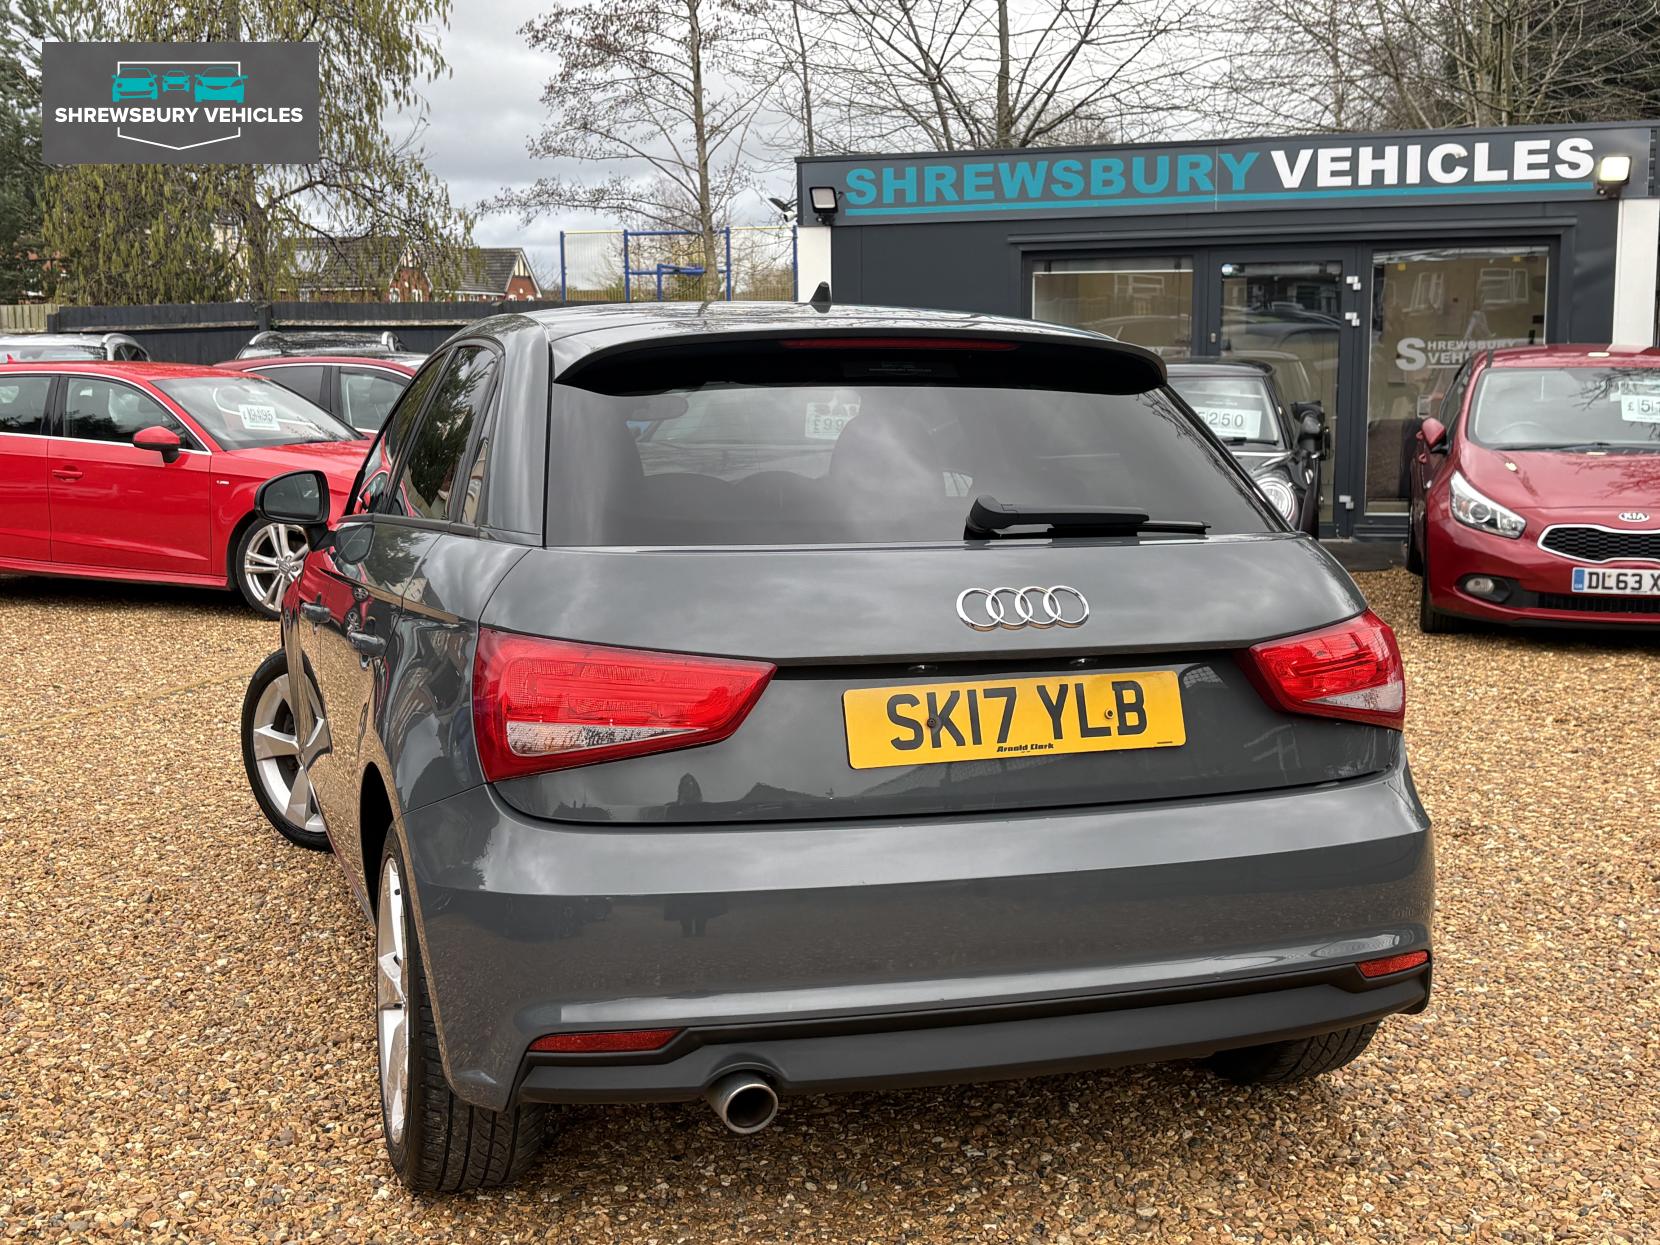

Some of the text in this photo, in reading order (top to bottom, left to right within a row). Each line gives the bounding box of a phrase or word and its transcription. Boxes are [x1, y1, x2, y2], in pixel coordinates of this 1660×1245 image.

[845, 137, 1595, 206] SHREWSBURY VEHICLES
[1587, 571, 1643, 591] DL63
[886, 680, 1148, 751] SK17 YLB
[996, 744, 1028, 753] Arnold
[1030, 742, 1054, 751] Clark
